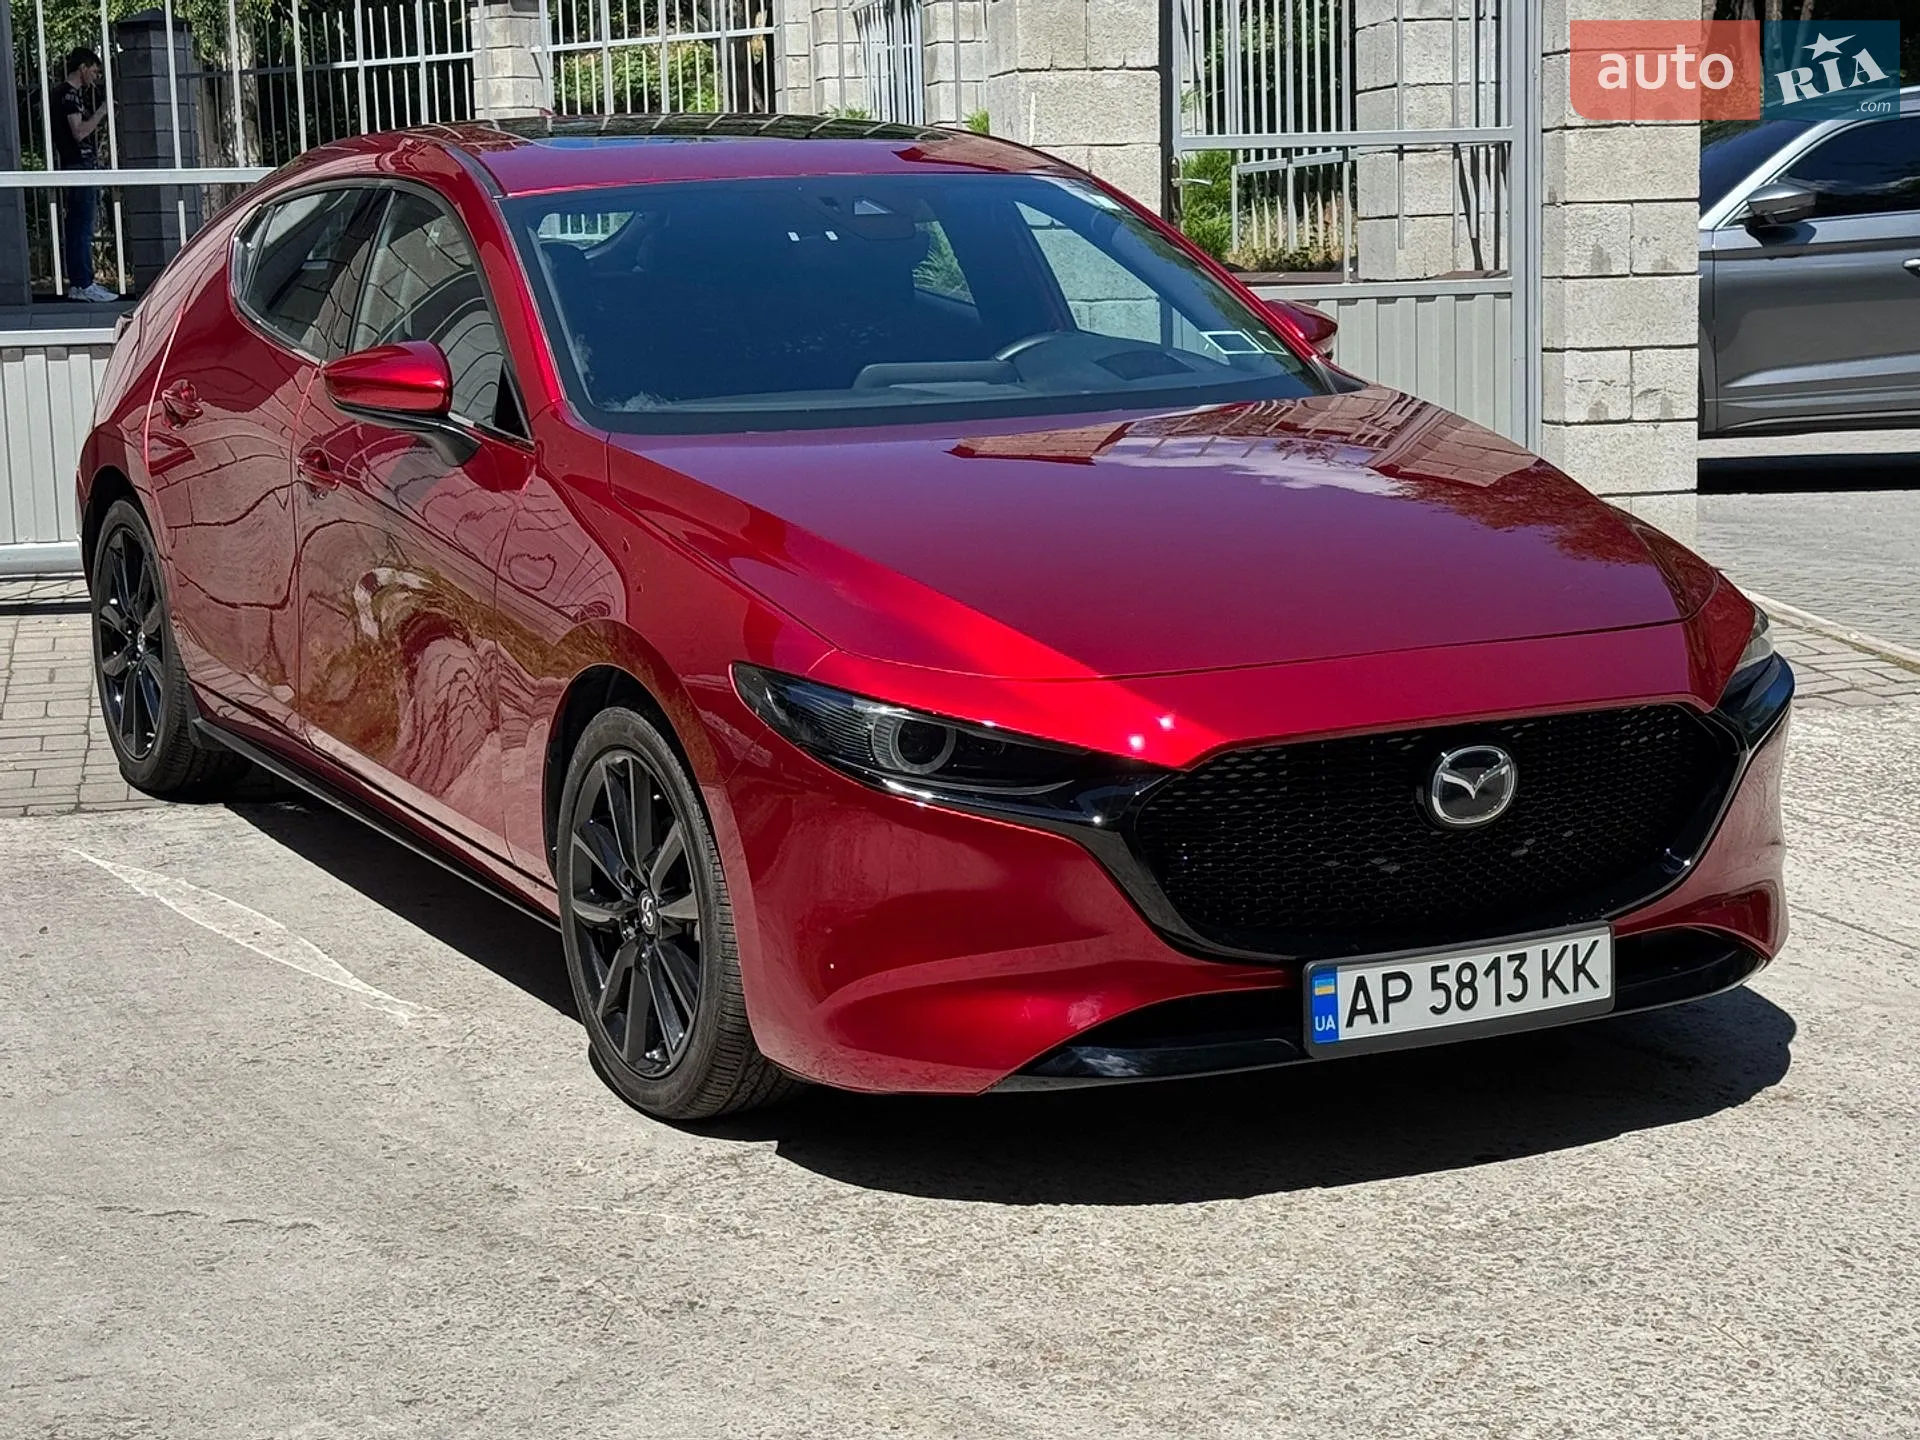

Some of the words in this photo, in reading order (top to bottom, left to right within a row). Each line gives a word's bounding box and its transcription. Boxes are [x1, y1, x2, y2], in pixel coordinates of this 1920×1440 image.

[1345, 971, 1412, 1028] AP
[1428, 952, 1529, 1015] 5813
[1541, 939, 1600, 999] KK
[1314, 1015, 1336, 1031] UA
